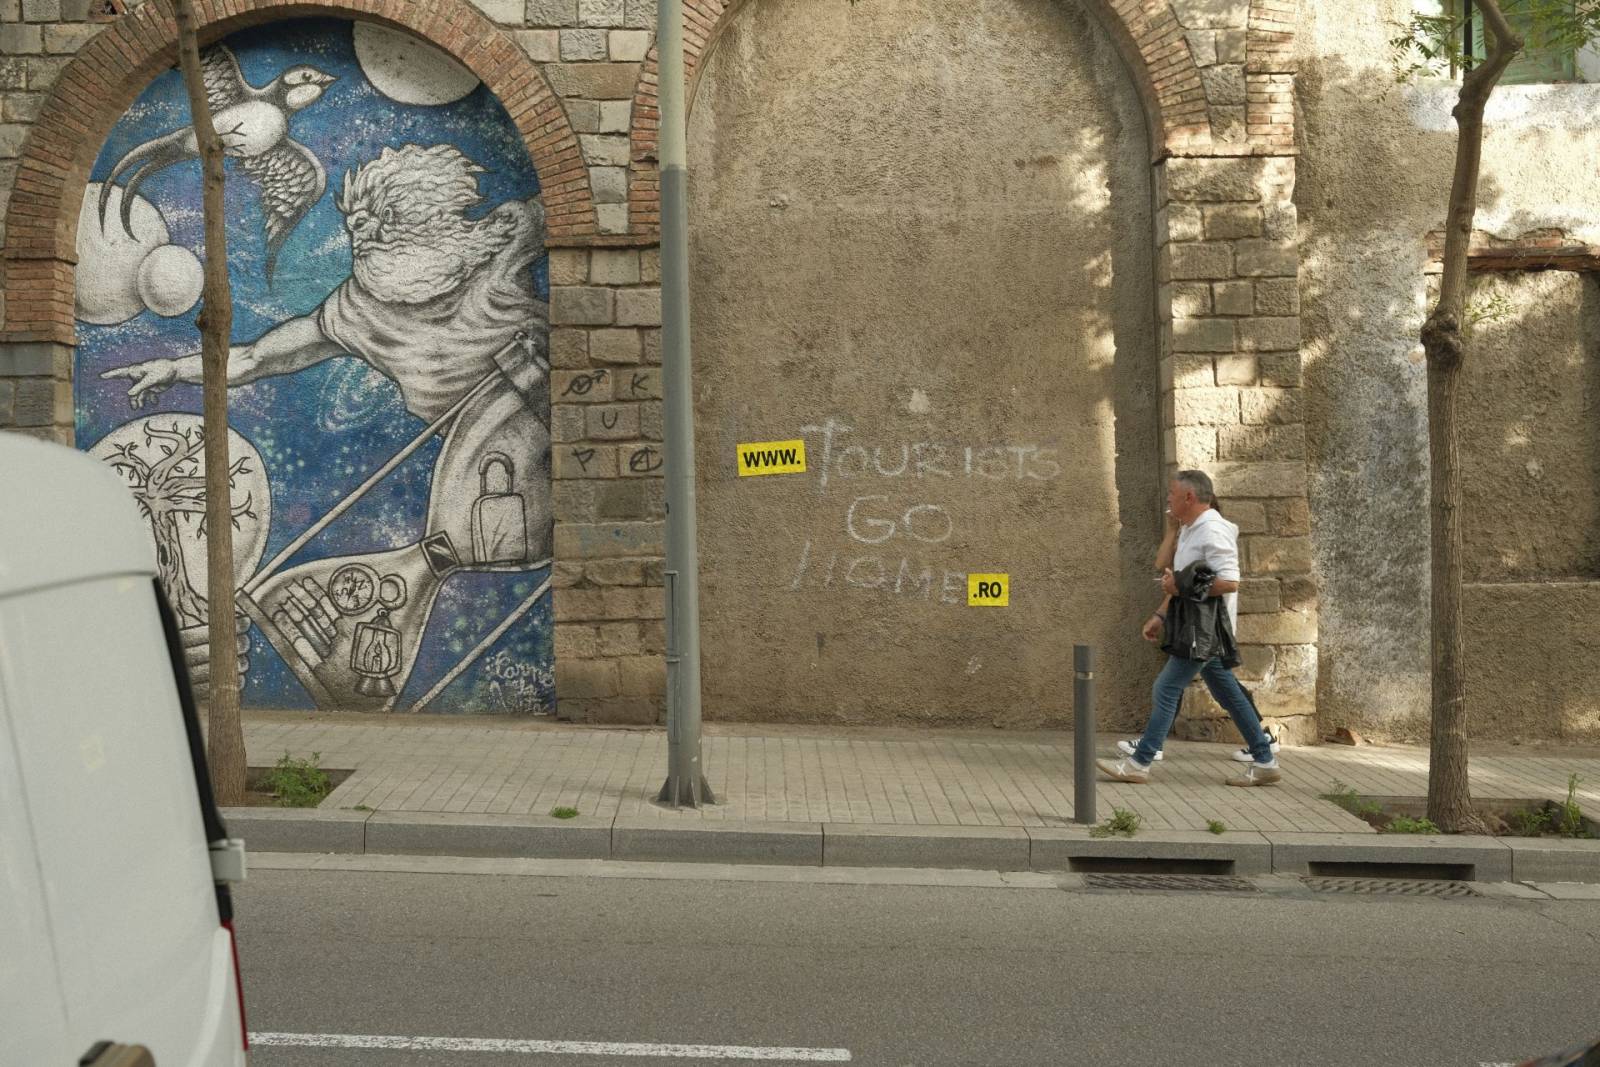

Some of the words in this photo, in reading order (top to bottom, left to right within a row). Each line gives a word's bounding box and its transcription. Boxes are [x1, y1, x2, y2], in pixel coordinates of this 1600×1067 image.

[602, 411, 618, 430] U
[743, 448, 801, 468] WWW.
[847, 495, 952, 543] GO
[972, 581, 1002, 599] .RO
